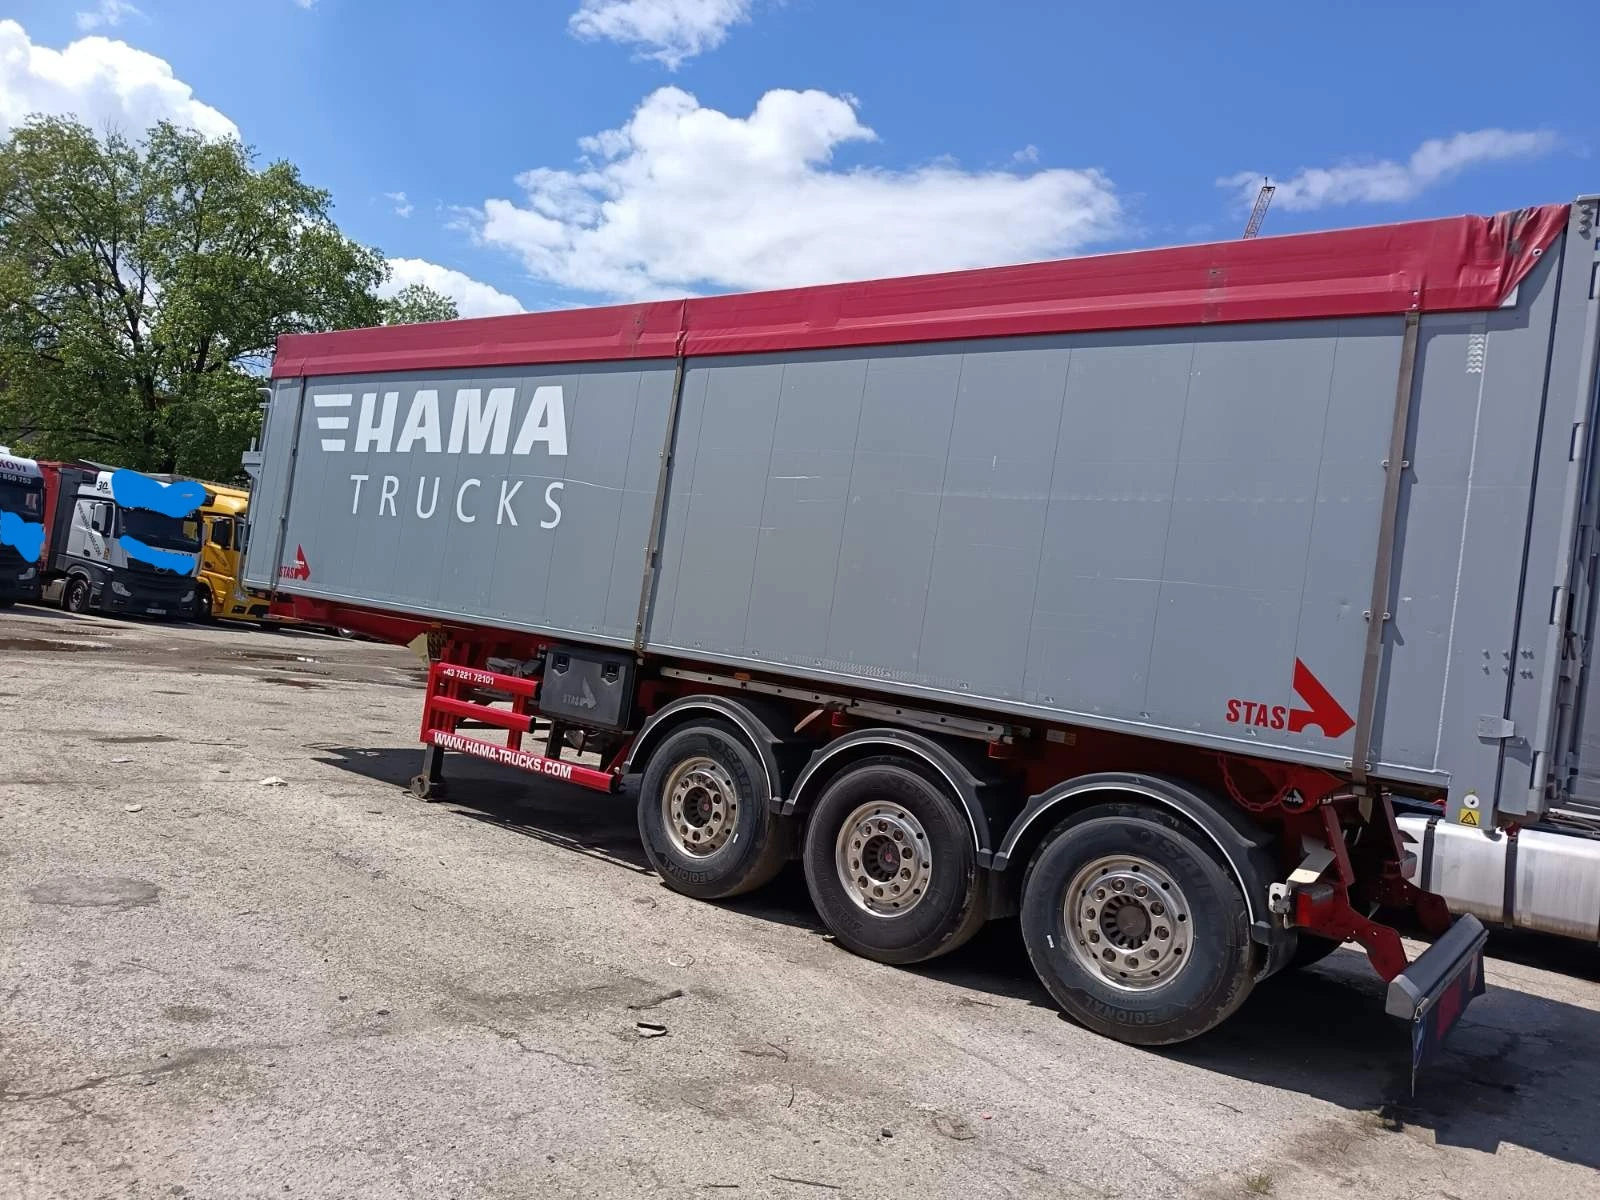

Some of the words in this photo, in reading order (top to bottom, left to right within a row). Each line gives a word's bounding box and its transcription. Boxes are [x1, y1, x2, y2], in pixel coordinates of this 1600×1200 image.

[354, 385, 568, 456] HAMA
[351, 474, 565, 530] TRUCKS
[456, 670, 472, 681] 7221
[473, 673, 495, 686] 72101
[1226, 699, 1287, 731] STAS
[433, 731, 573, 780] WWW.HAMA-TRUCKS.COM
